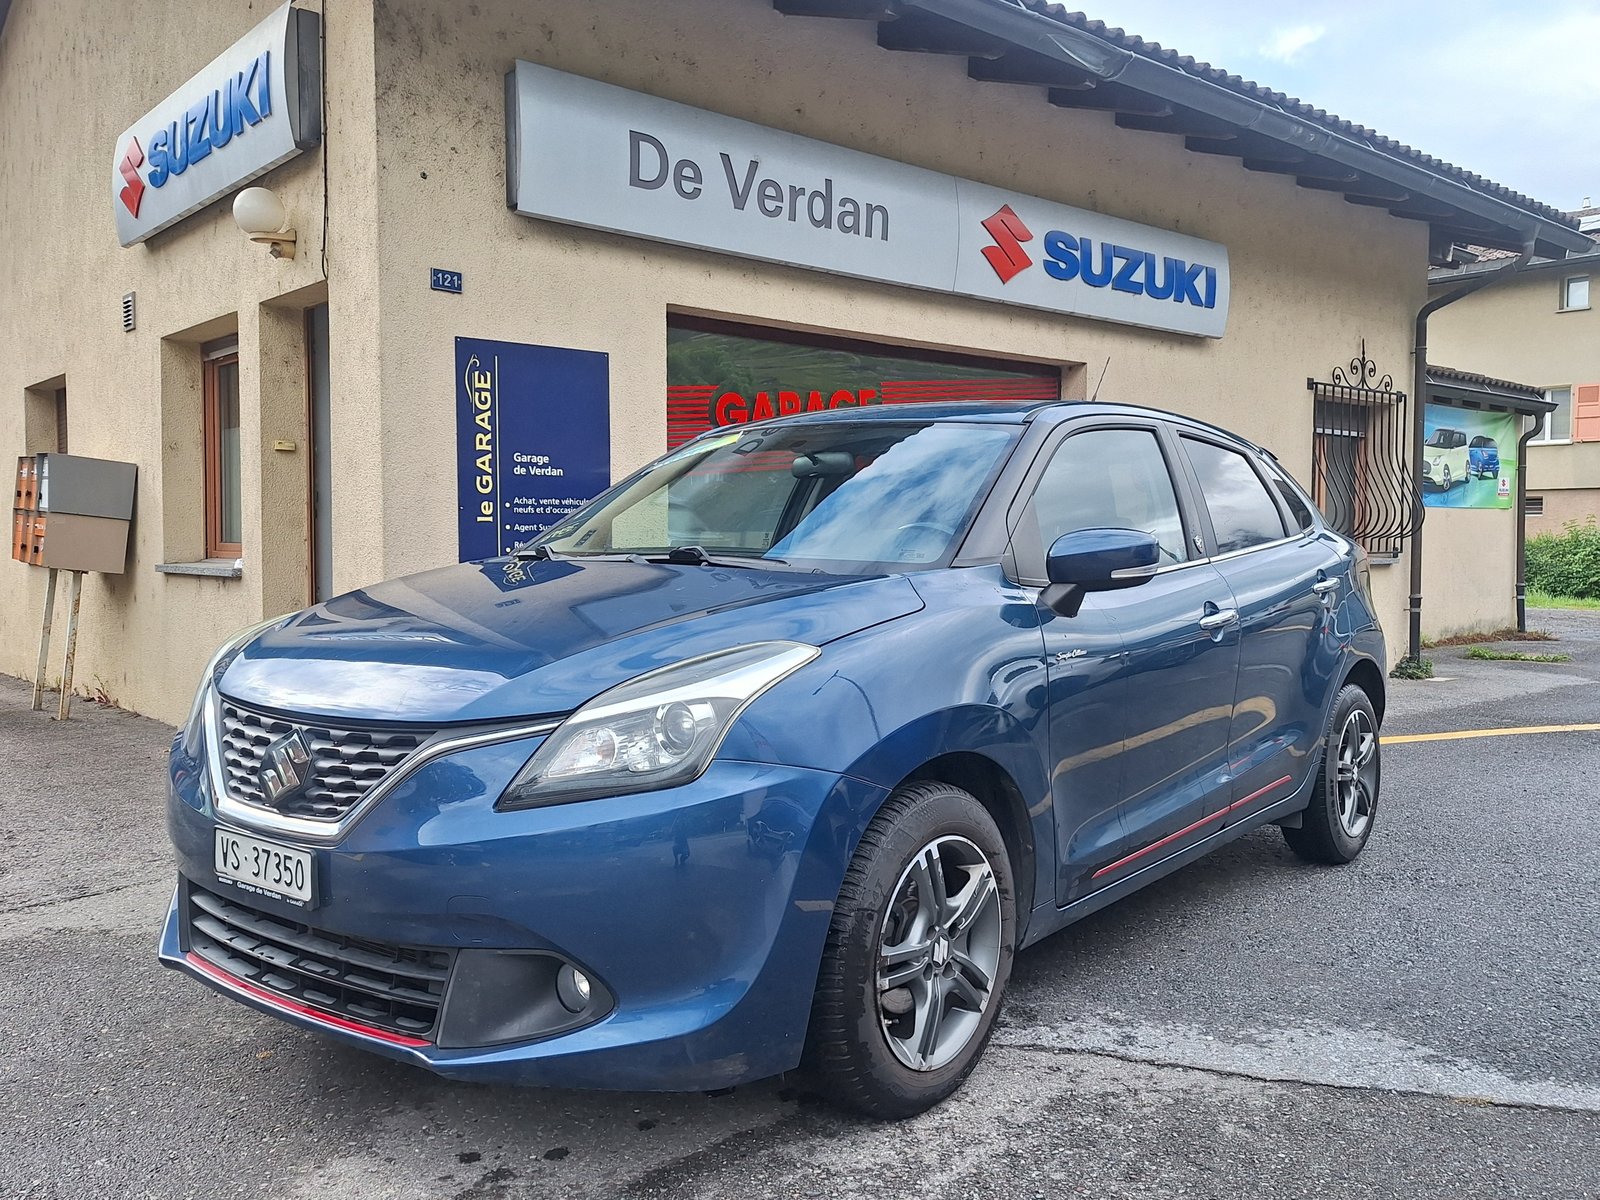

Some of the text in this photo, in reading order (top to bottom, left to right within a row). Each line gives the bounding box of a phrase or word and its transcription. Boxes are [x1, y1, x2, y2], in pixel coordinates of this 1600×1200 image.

[147, 50, 272, 188] SUZUKI
[628, 130, 889, 242] De Verdan
[1043, 230, 1217, 309] SUZUKI
[436, 272, 459, 288] 121
[474, 370, 494, 523] le GARAGE
[513, 452, 550, 465] Garage
[513, 465, 564, 476] de Verdan
[513, 497, 538, 505] Achat,
[513, 506, 535, 514] neufs
[536, 506, 544, 514] et
[513, 524, 537, 532] Agent
